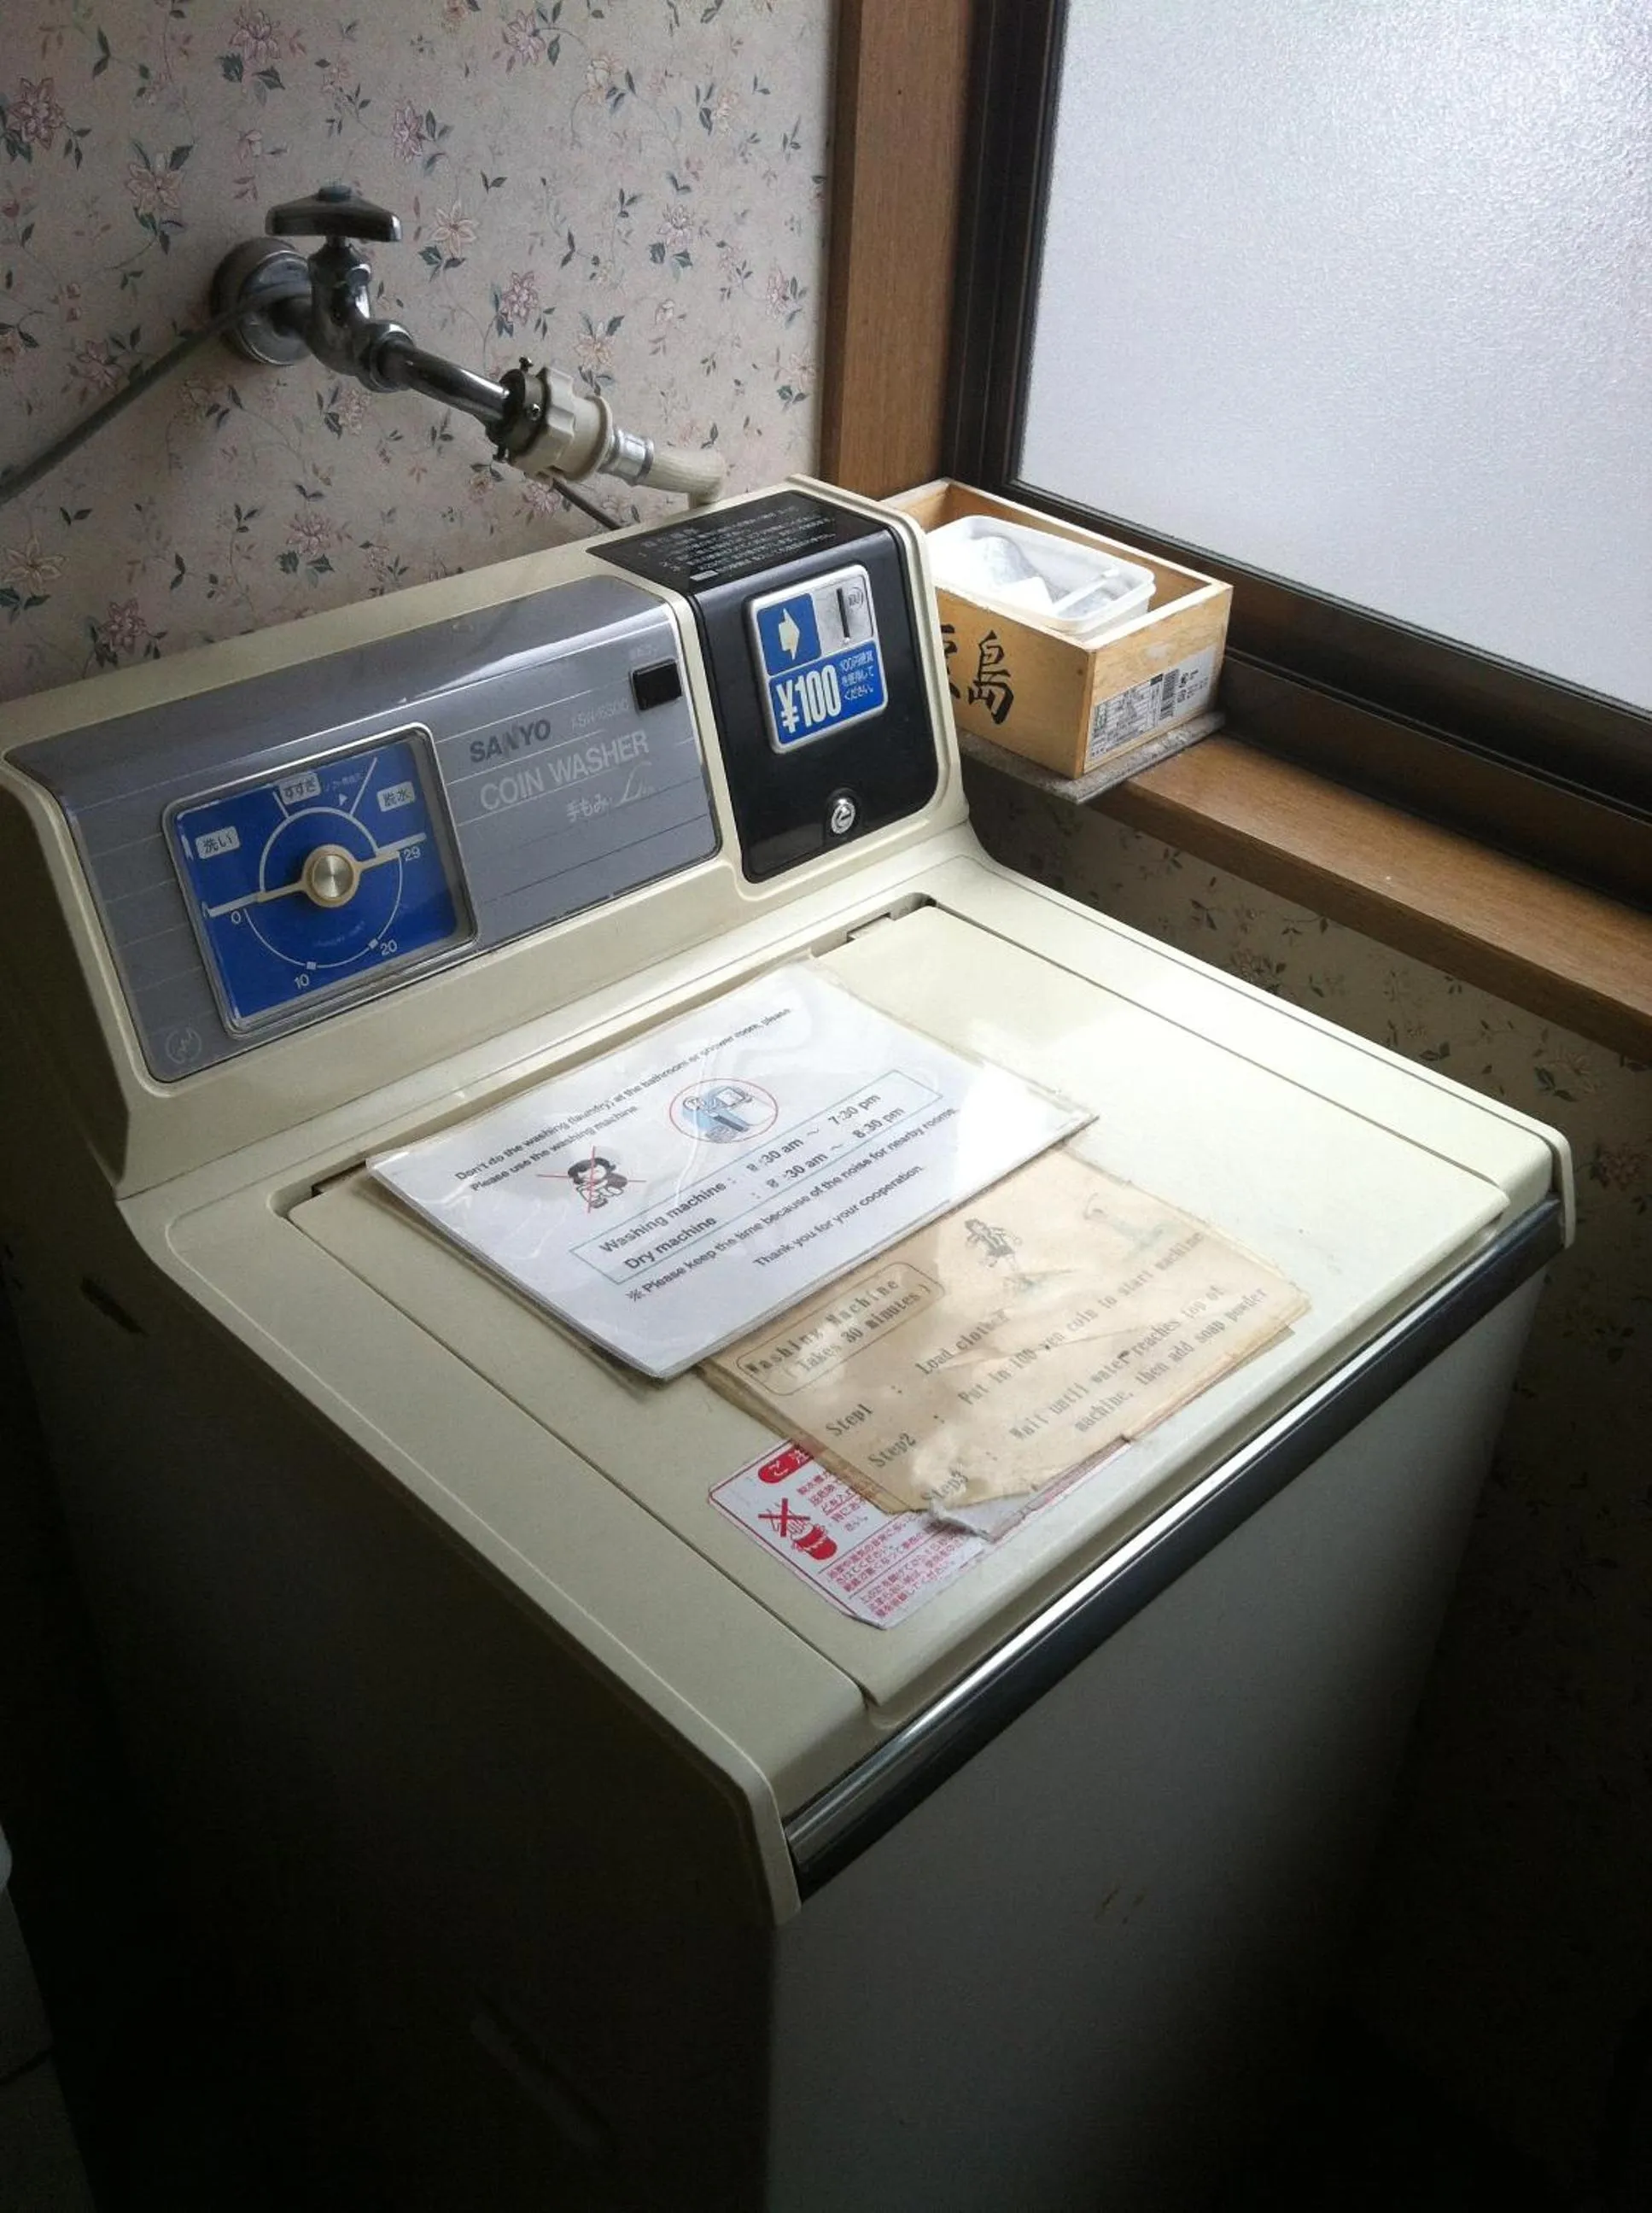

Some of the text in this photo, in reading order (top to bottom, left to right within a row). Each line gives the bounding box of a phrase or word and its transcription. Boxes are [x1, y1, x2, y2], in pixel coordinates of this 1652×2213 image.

[775, 664, 842, 733] ¥100
[470, 719, 552, 762] SANYO
[479, 730, 650, 811] COIN WASHER
[231, 910, 242, 924] 0
[380, 939, 399, 956] 20
[294, 973, 310, 989] 10
[488, 1154, 505, 1165] do
[503, 1145, 523, 1157] the
[522, 1122, 570, 1147] washing
[623, 1085, 643, 1096] the
[470, 1171, 510, 1191] Please
[509, 1159, 531, 1173] use
[529, 1149, 551, 1161] the
[550, 1126, 596, 1151] washing
[598, 1216, 669, 1252] Washing
[666, 1182, 727, 1218] machine
[781, 1137, 804, 1153] am
[828, 1106, 859, 1125] 7:30
[858, 1094, 881, 1111] pm
[624, 1250, 656, 1270] Dry
[655, 1217, 717, 1253] machine
[805, 1152, 828, 1169] am
[853, 1118, 883, 1139] 8:30
[883, 1107, 905, 1124] pm
[642, 1266, 686, 1293] Please
[683, 1250, 716, 1270] keep
[715, 1237, 738, 1252] the
[734, 1223, 763, 1241] time
[760, 1195, 810, 1225] because
[809, 1186, 824, 1197] of
[820, 1177, 843, 1190] the
[841, 1157, 872, 1179] noise
[869, 1148, 888, 1161] for
[887, 1127, 925, 1151] nearby
[752, 1244, 795, 1265] Thank
[792, 1232, 817, 1247] you
[814, 1220, 833, 1233] for
[832, 1204, 859, 1224] your
[826, 1280, 899, 1325] Machine
[841, 1327, 864, 1344] 30
[865, 1292, 921, 1329] minutes
[1166, 1339, 1196, 1363] add
[826, 1403, 873, 1437] Step1
[915, 1347, 955, 1375] Load
[867, 1431, 917, 1469] Step2
[958, 1383, 989, 1405] Put
